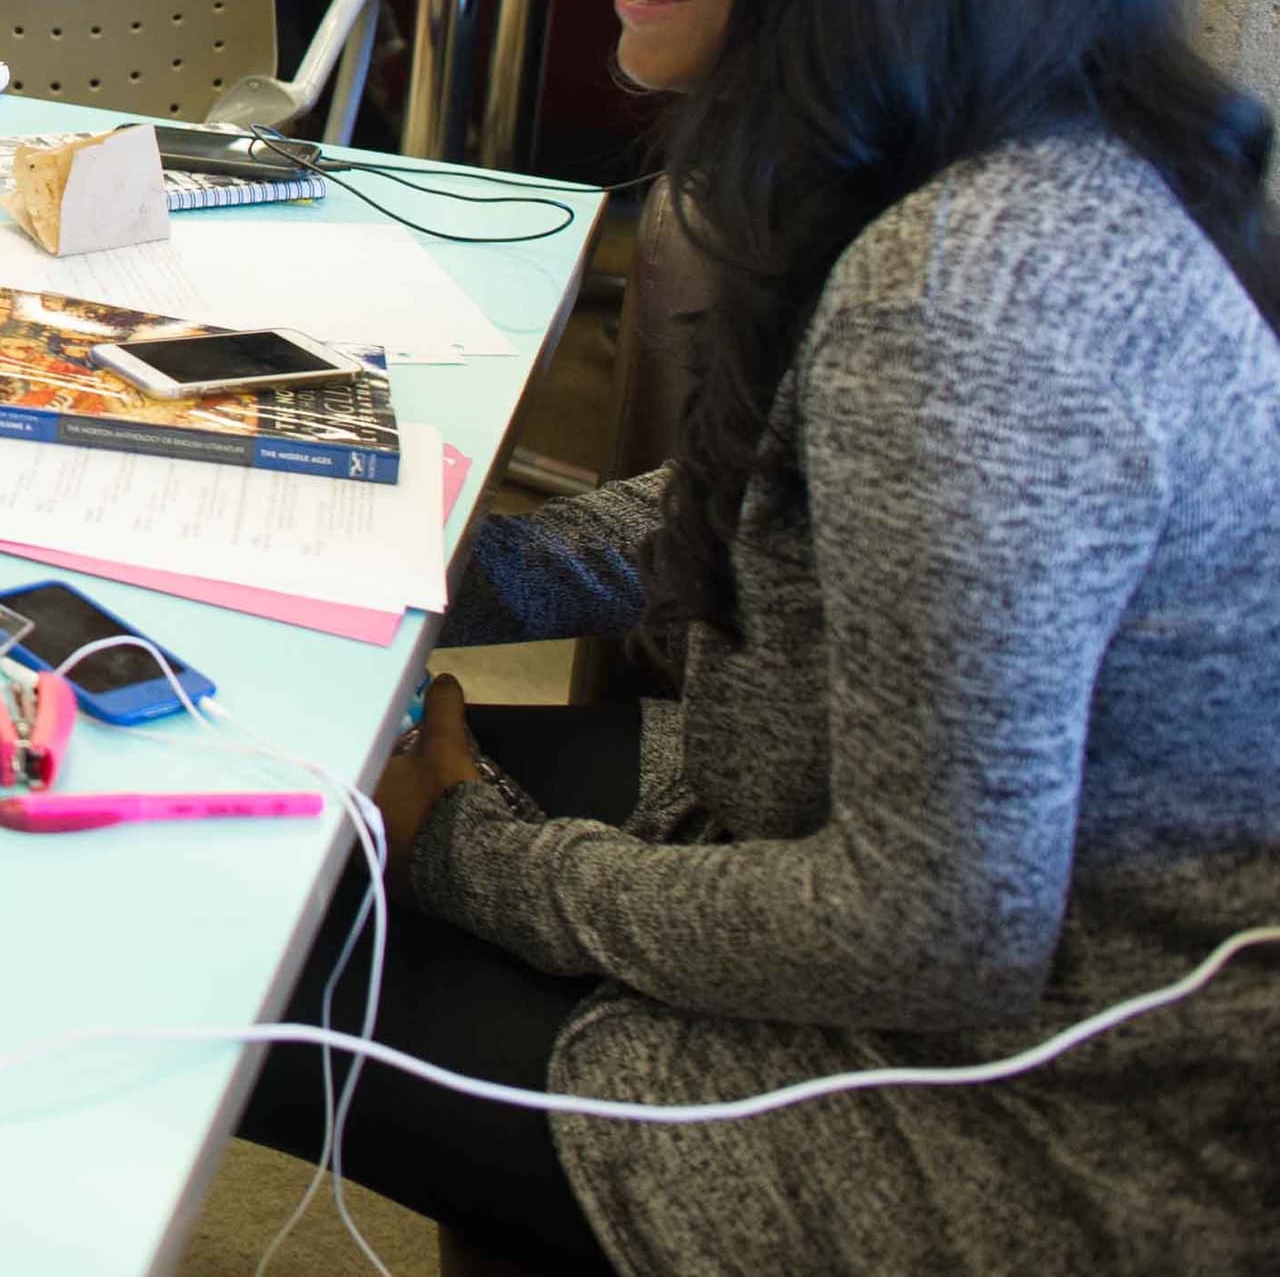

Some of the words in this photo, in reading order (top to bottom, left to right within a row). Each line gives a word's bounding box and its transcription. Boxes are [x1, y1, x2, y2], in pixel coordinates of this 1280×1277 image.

[66, 424, 81, 434] THE
[260, 449, 276, 459] THE
[278, 452, 309, 463] MIDDLE
[310, 455, 334, 466] AGES
